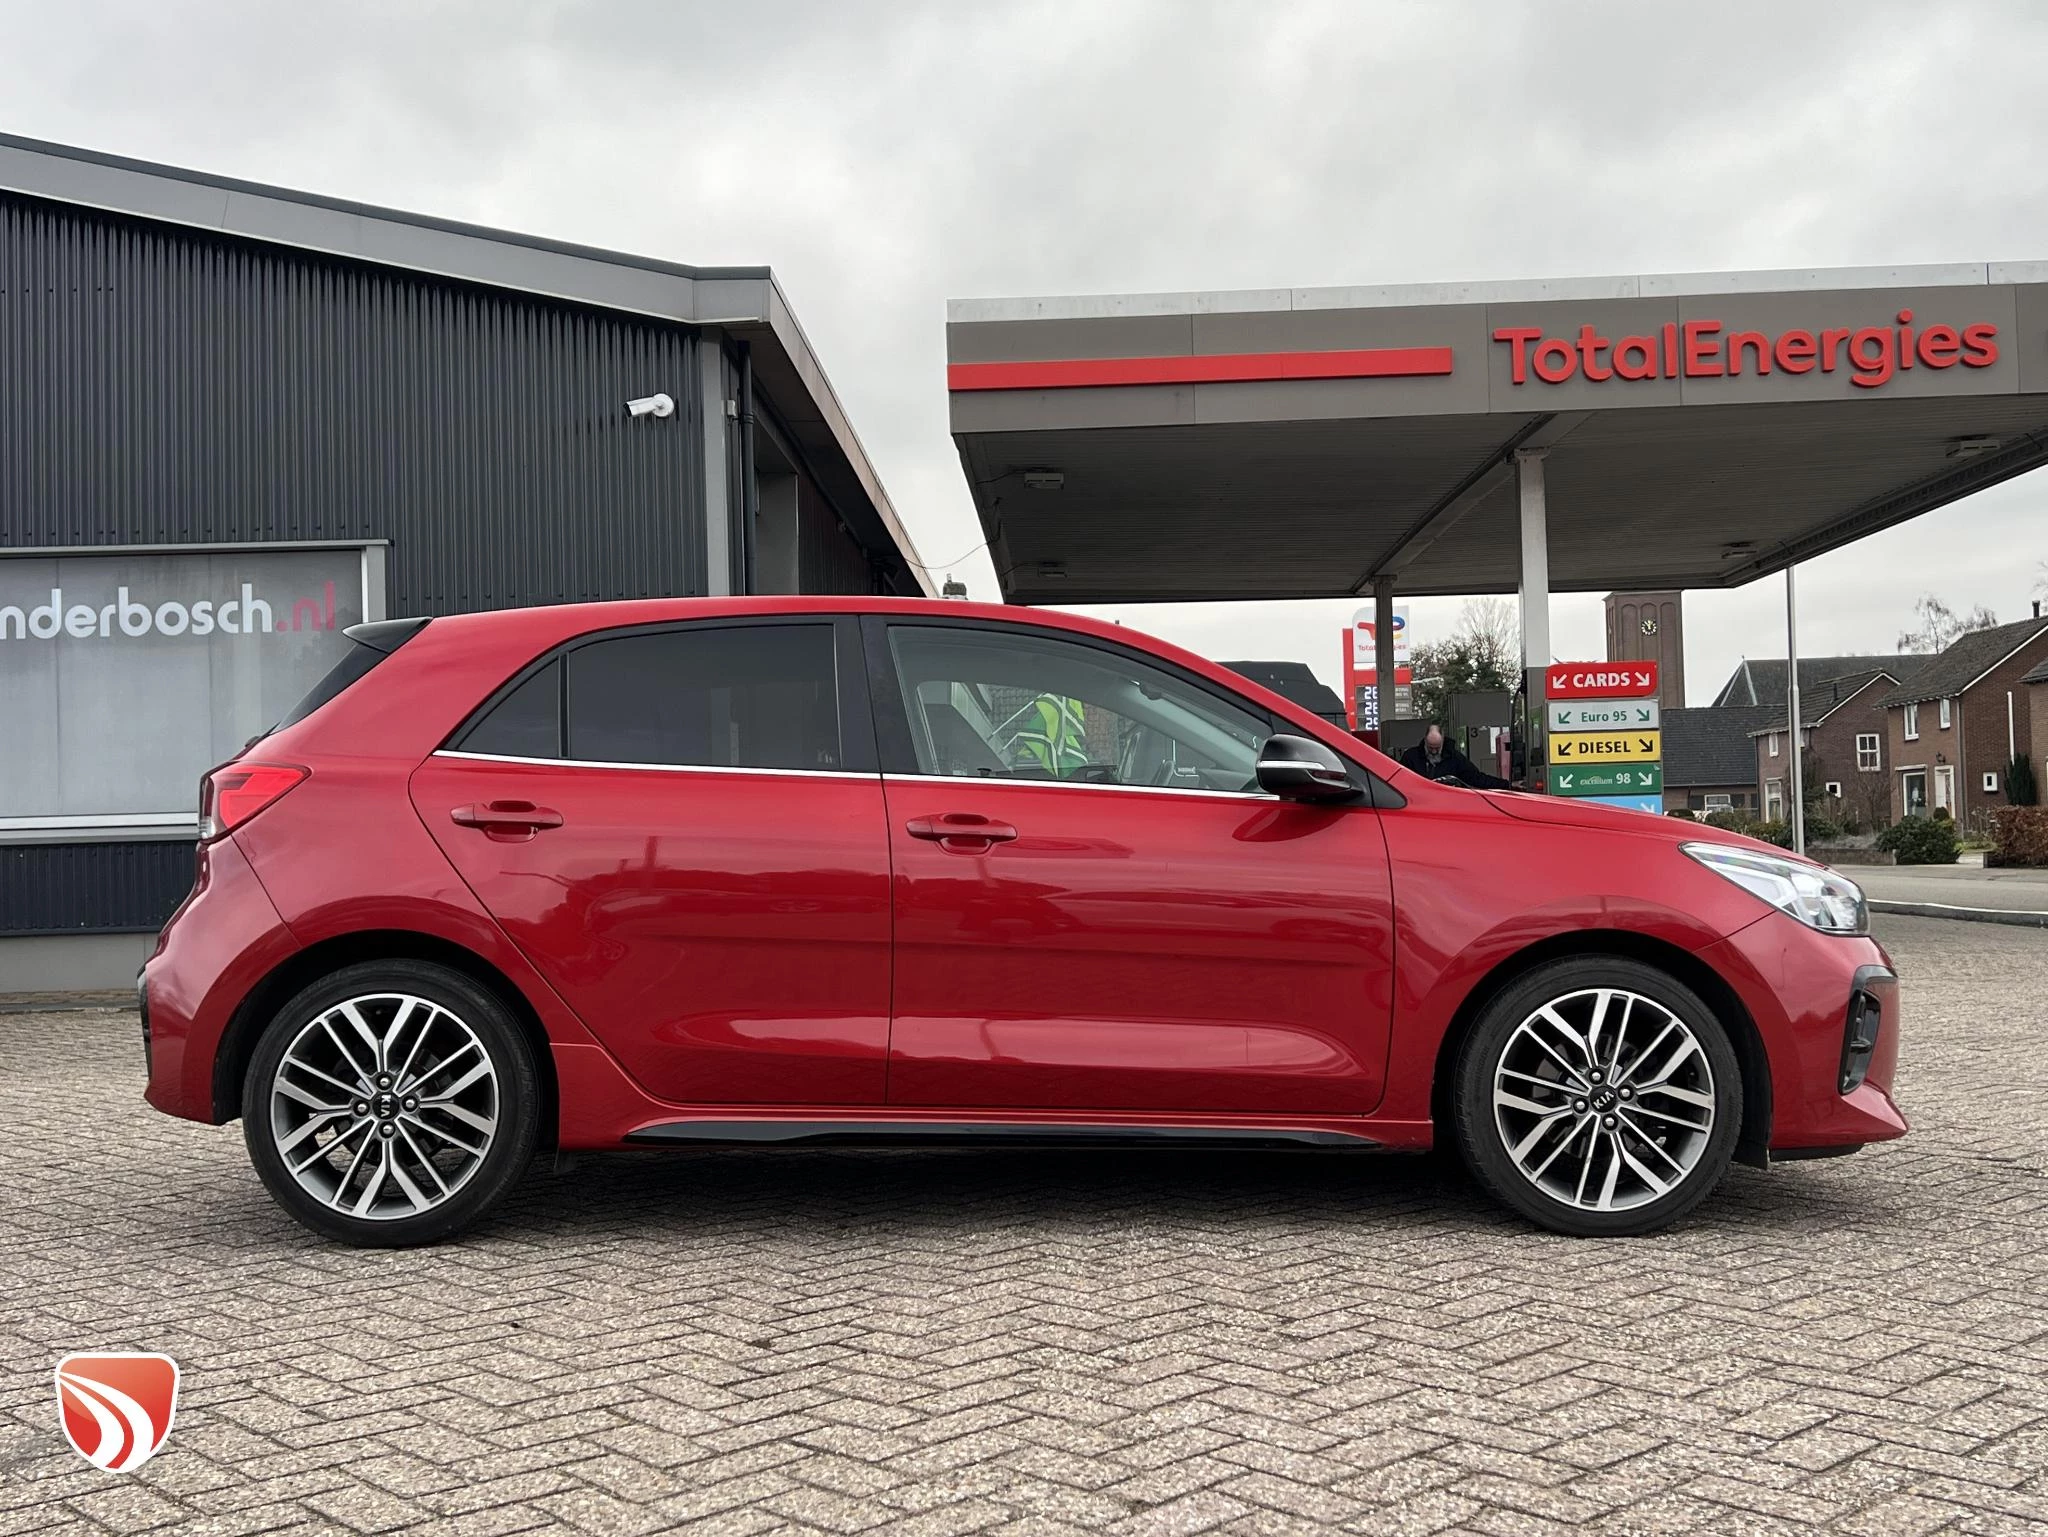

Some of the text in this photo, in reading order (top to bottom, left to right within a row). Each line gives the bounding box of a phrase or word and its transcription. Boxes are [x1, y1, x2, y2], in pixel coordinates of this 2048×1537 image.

[1493, 308, 1998, 388] TotalEnergies
[1572, 671, 1631, 688] CARDS
[1581, 710, 1628, 723] Euro 95
[1470, 727, 1479, 738] 3
[1578, 740, 1631, 754] DIESEL
[1615, 772, 1631, 785] 98
[381, 1094, 392, 1117] KIA
[1593, 1091, 1615, 1109] KIA
